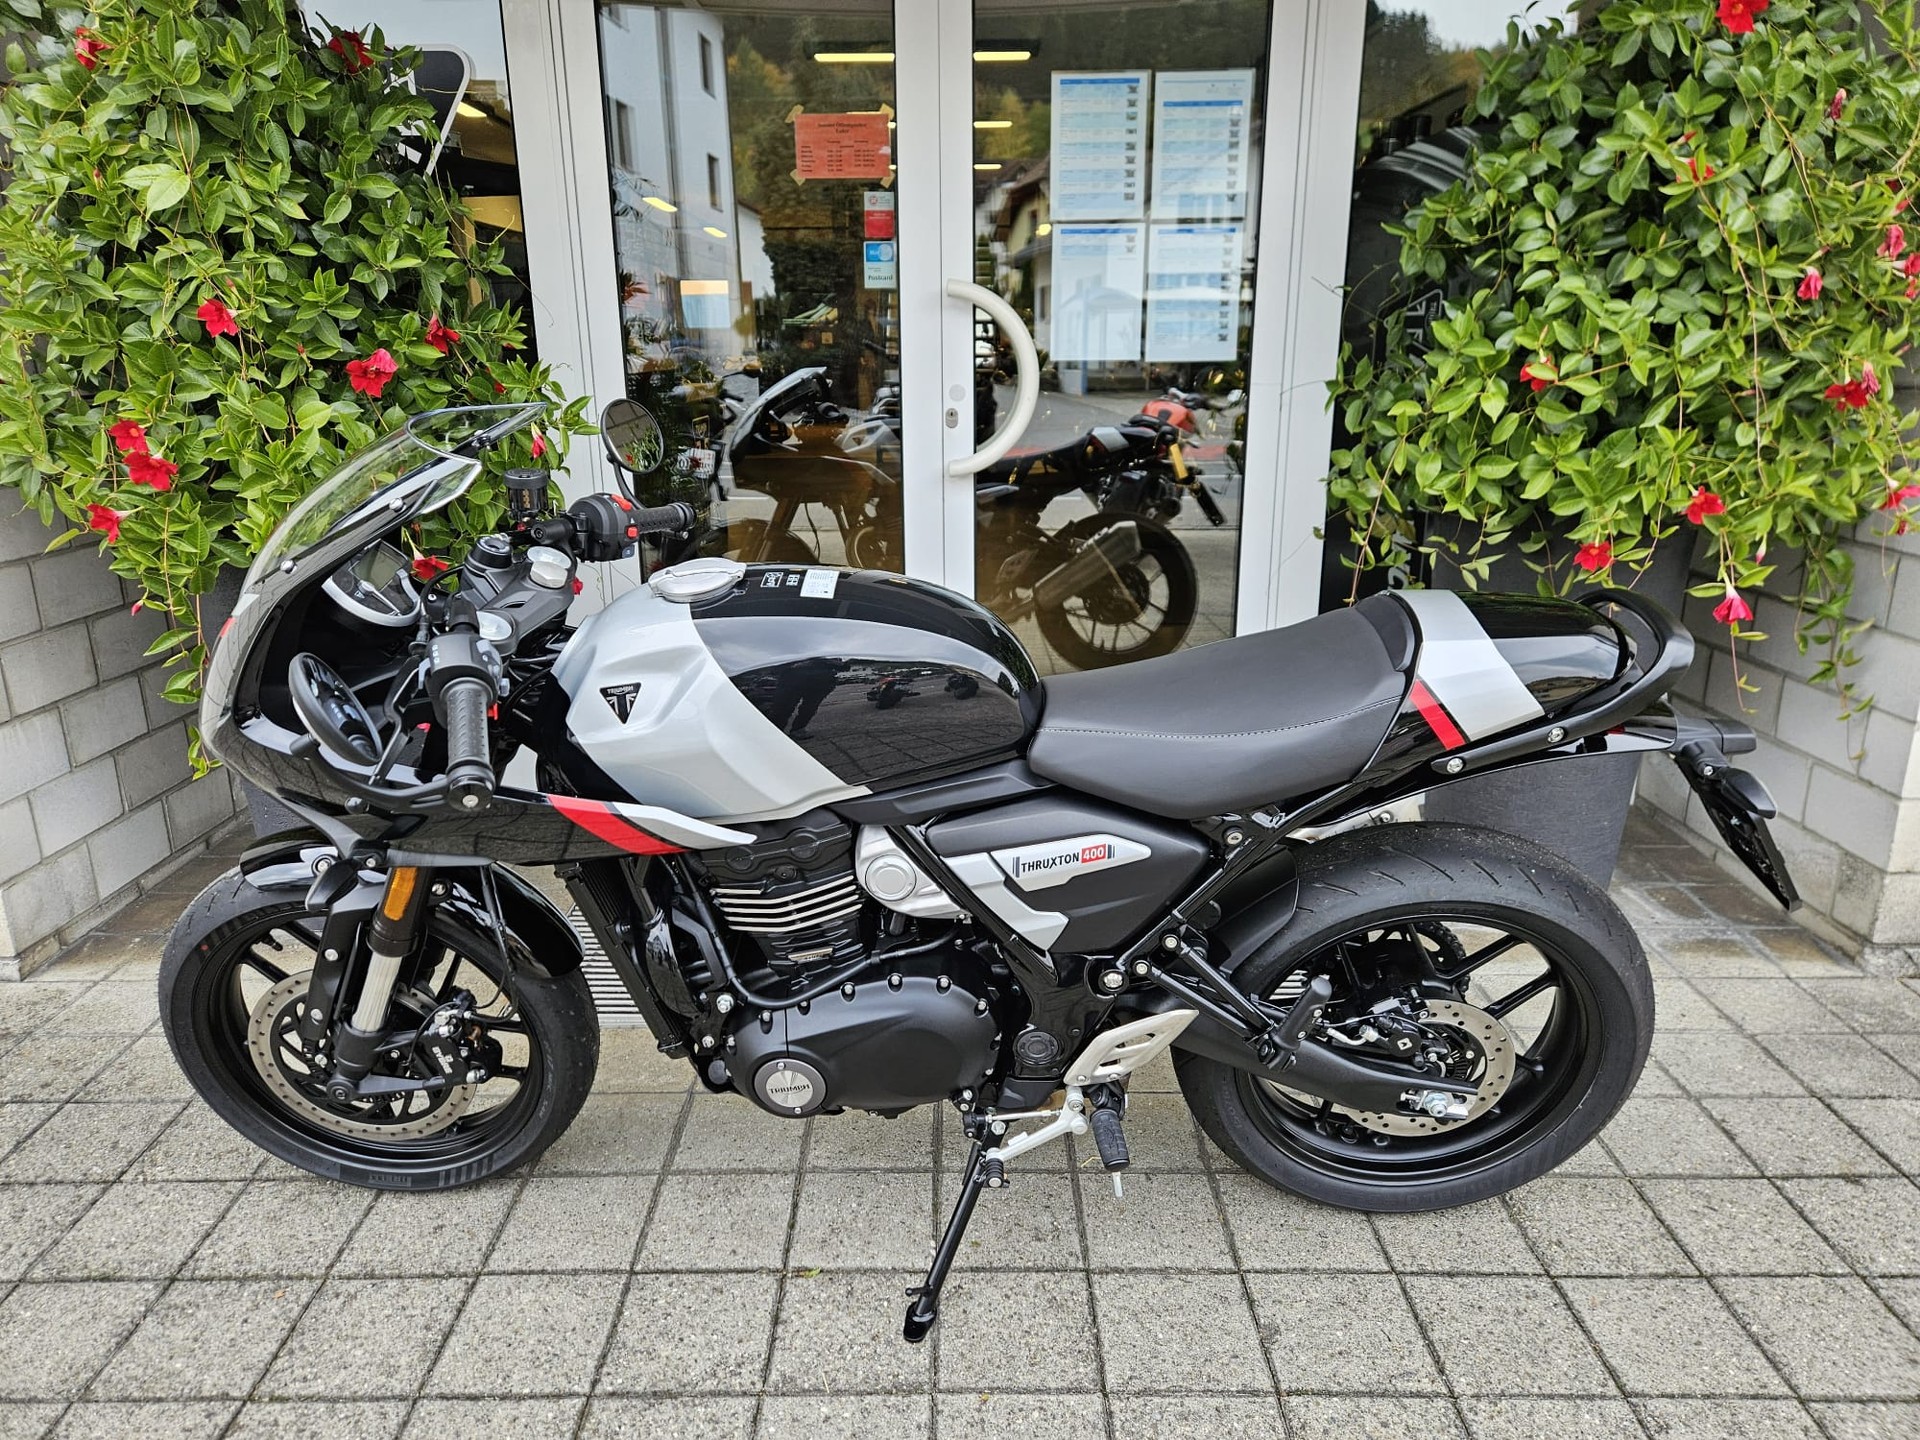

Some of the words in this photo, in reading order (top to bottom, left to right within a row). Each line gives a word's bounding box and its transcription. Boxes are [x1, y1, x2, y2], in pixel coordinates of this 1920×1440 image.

[606, 685, 634, 695] TRIUMPH
[1021, 852, 1080, 873] THRUXTON
[1083, 846, 1105, 861] 400
[768, 1084, 811, 1095] TRIUMPH
